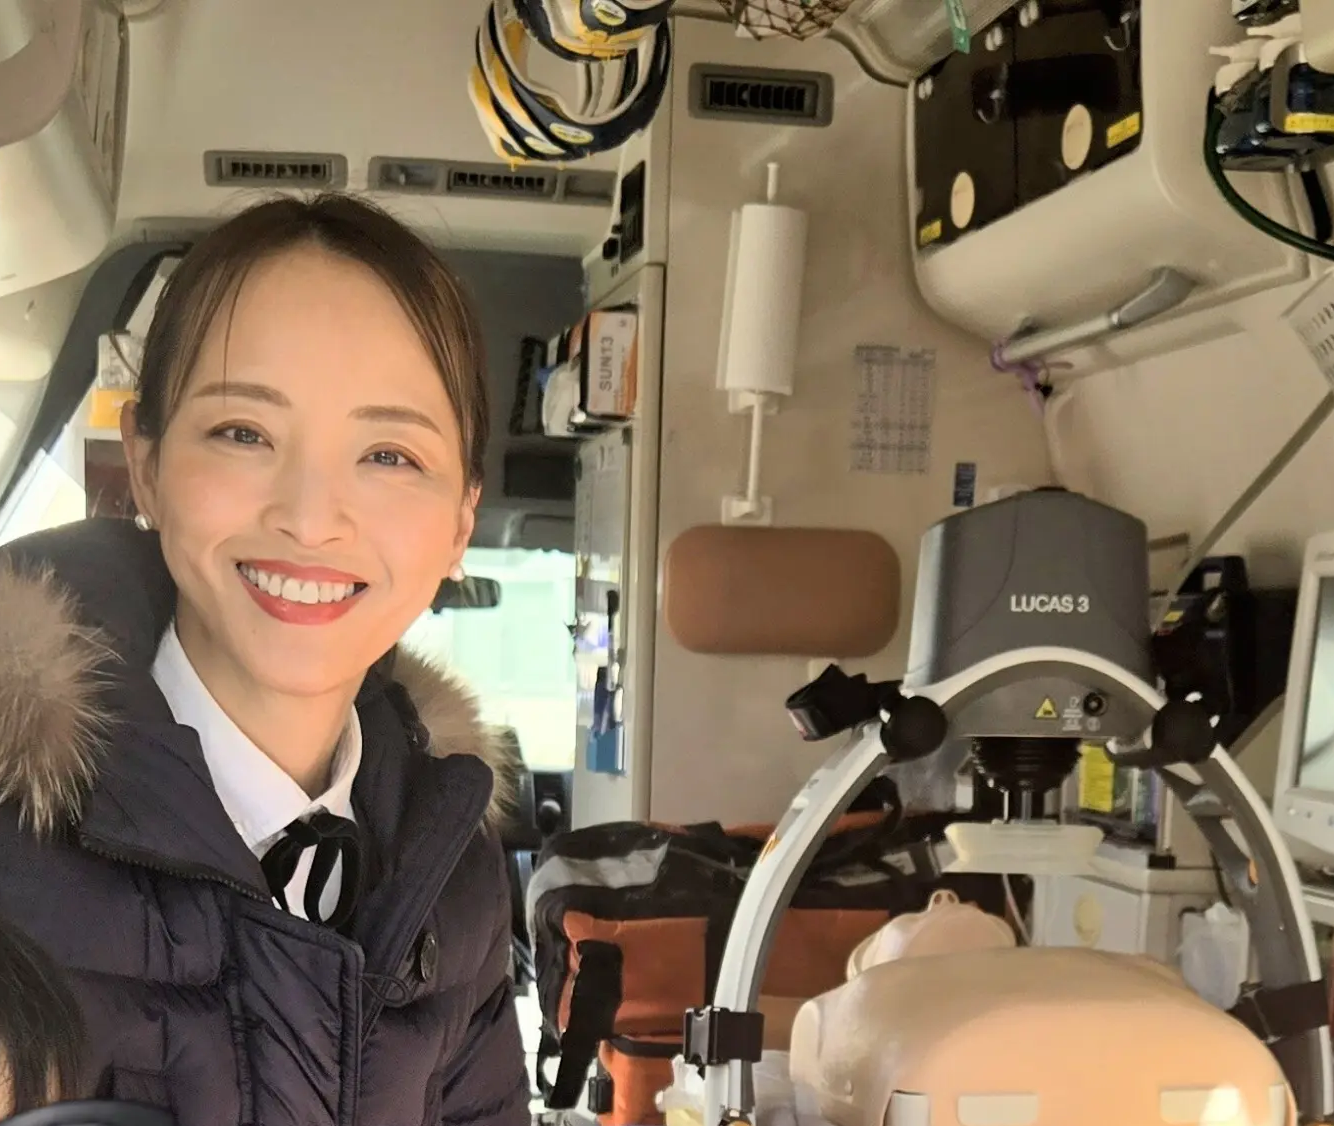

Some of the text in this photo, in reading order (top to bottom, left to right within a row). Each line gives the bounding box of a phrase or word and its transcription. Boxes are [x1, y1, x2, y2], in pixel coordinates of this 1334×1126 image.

[599, 336, 614, 392] SUN13
[1010, 594, 1090, 613] LUCAS 3
